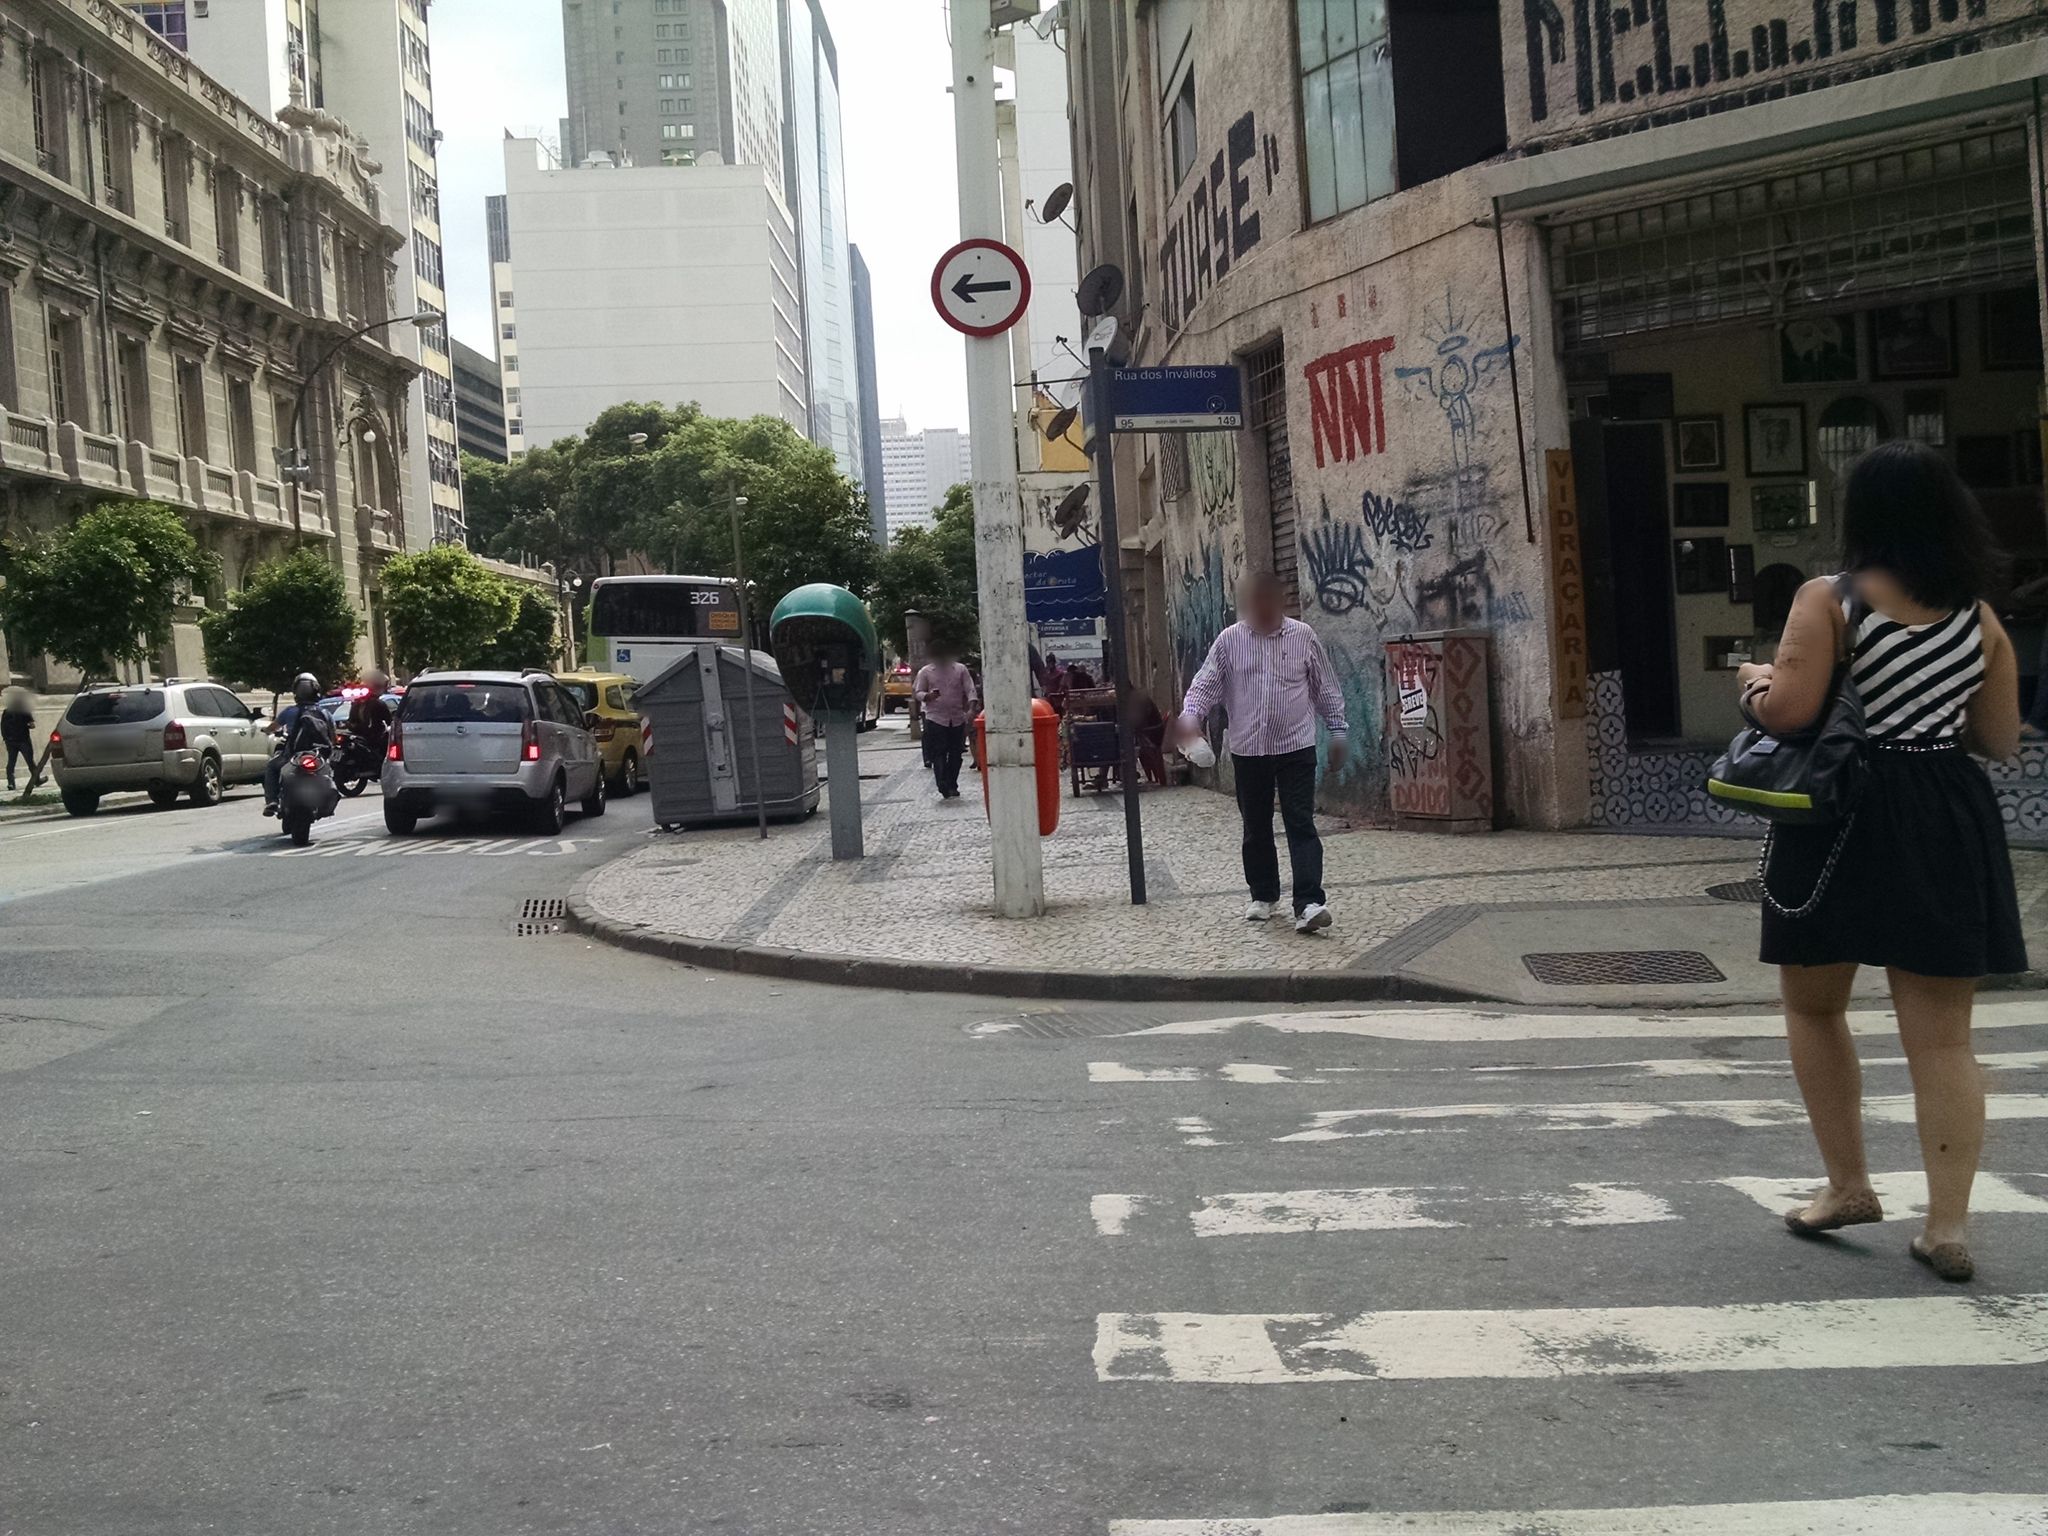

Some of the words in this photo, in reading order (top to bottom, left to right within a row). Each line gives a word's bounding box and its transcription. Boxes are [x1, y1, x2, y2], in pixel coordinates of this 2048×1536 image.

[1115, 370, 1137, 381] Rua
[1140, 369, 1162, 380] dos
[1165, 367, 1217, 380] Inválidos
[1120, 419, 1135, 429] 95
[1217, 416, 1236, 426] 149
[1552, 459, 1585, 705] VIDRAÇARIA
[690, 591, 720, 605] 326
